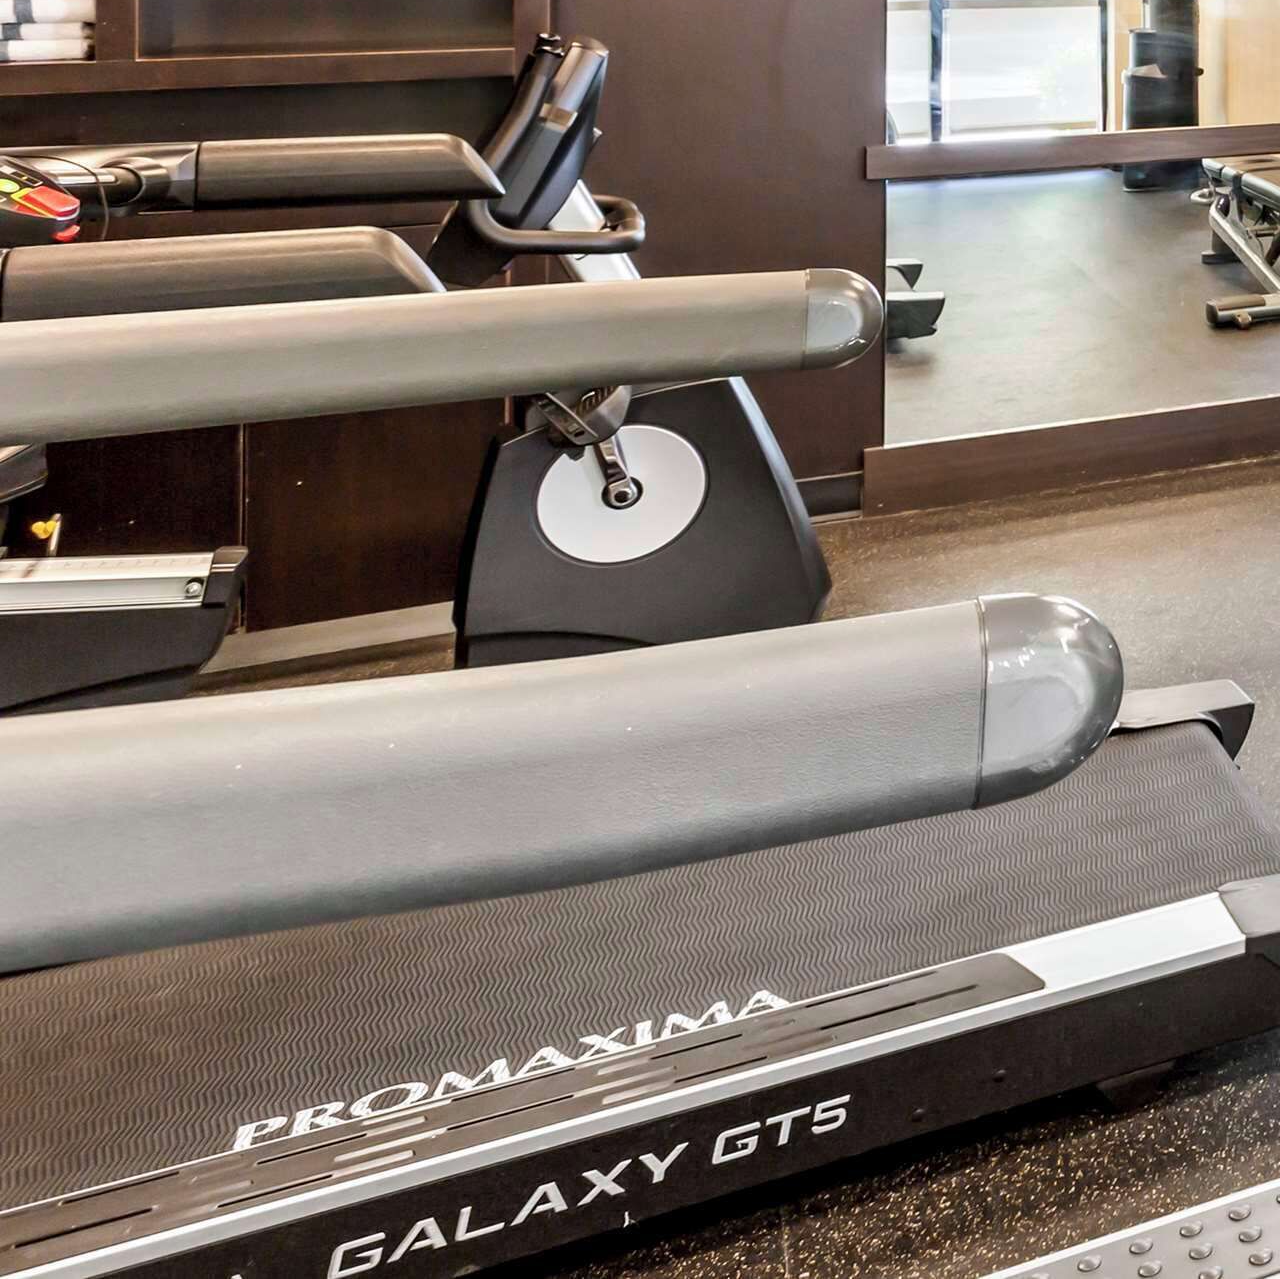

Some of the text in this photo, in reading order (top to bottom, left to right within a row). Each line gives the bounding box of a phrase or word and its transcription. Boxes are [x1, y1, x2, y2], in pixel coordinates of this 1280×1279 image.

[232, 989, 792, 1151] PROMAXIMA
[327, 1095, 852, 1279] GALAXY GT5
